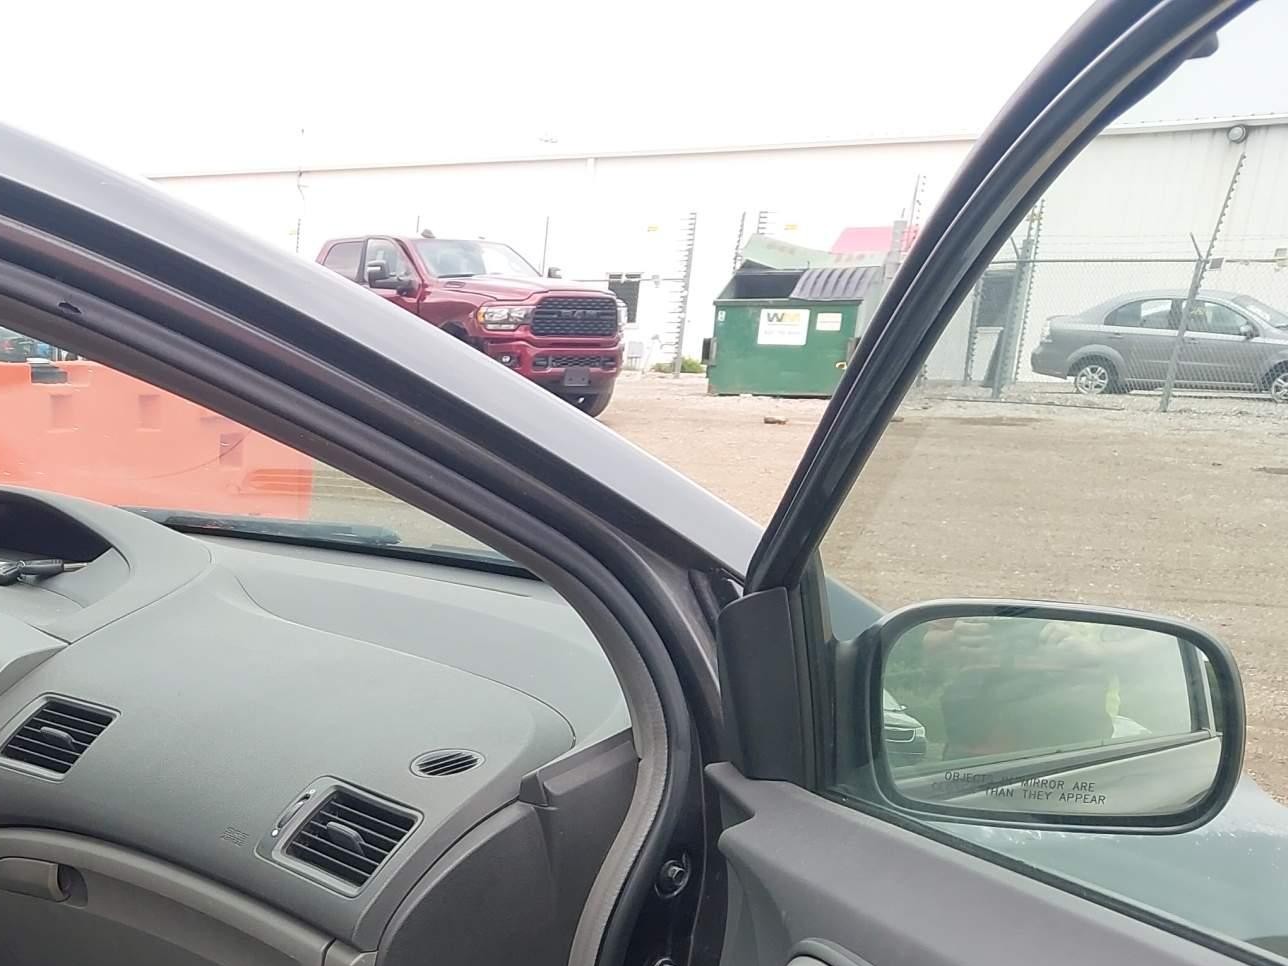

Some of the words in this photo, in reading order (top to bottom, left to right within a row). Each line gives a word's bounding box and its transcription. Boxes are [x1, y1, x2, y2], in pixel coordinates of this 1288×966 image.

[1021, 778, 1065, 790] MIRROR
[1072, 781, 1096, 792] ARE
[985, 786, 1015, 798] THAN
[1023, 789, 1053, 801] THEY
[1059, 792, 1106, 805] APPEAR
